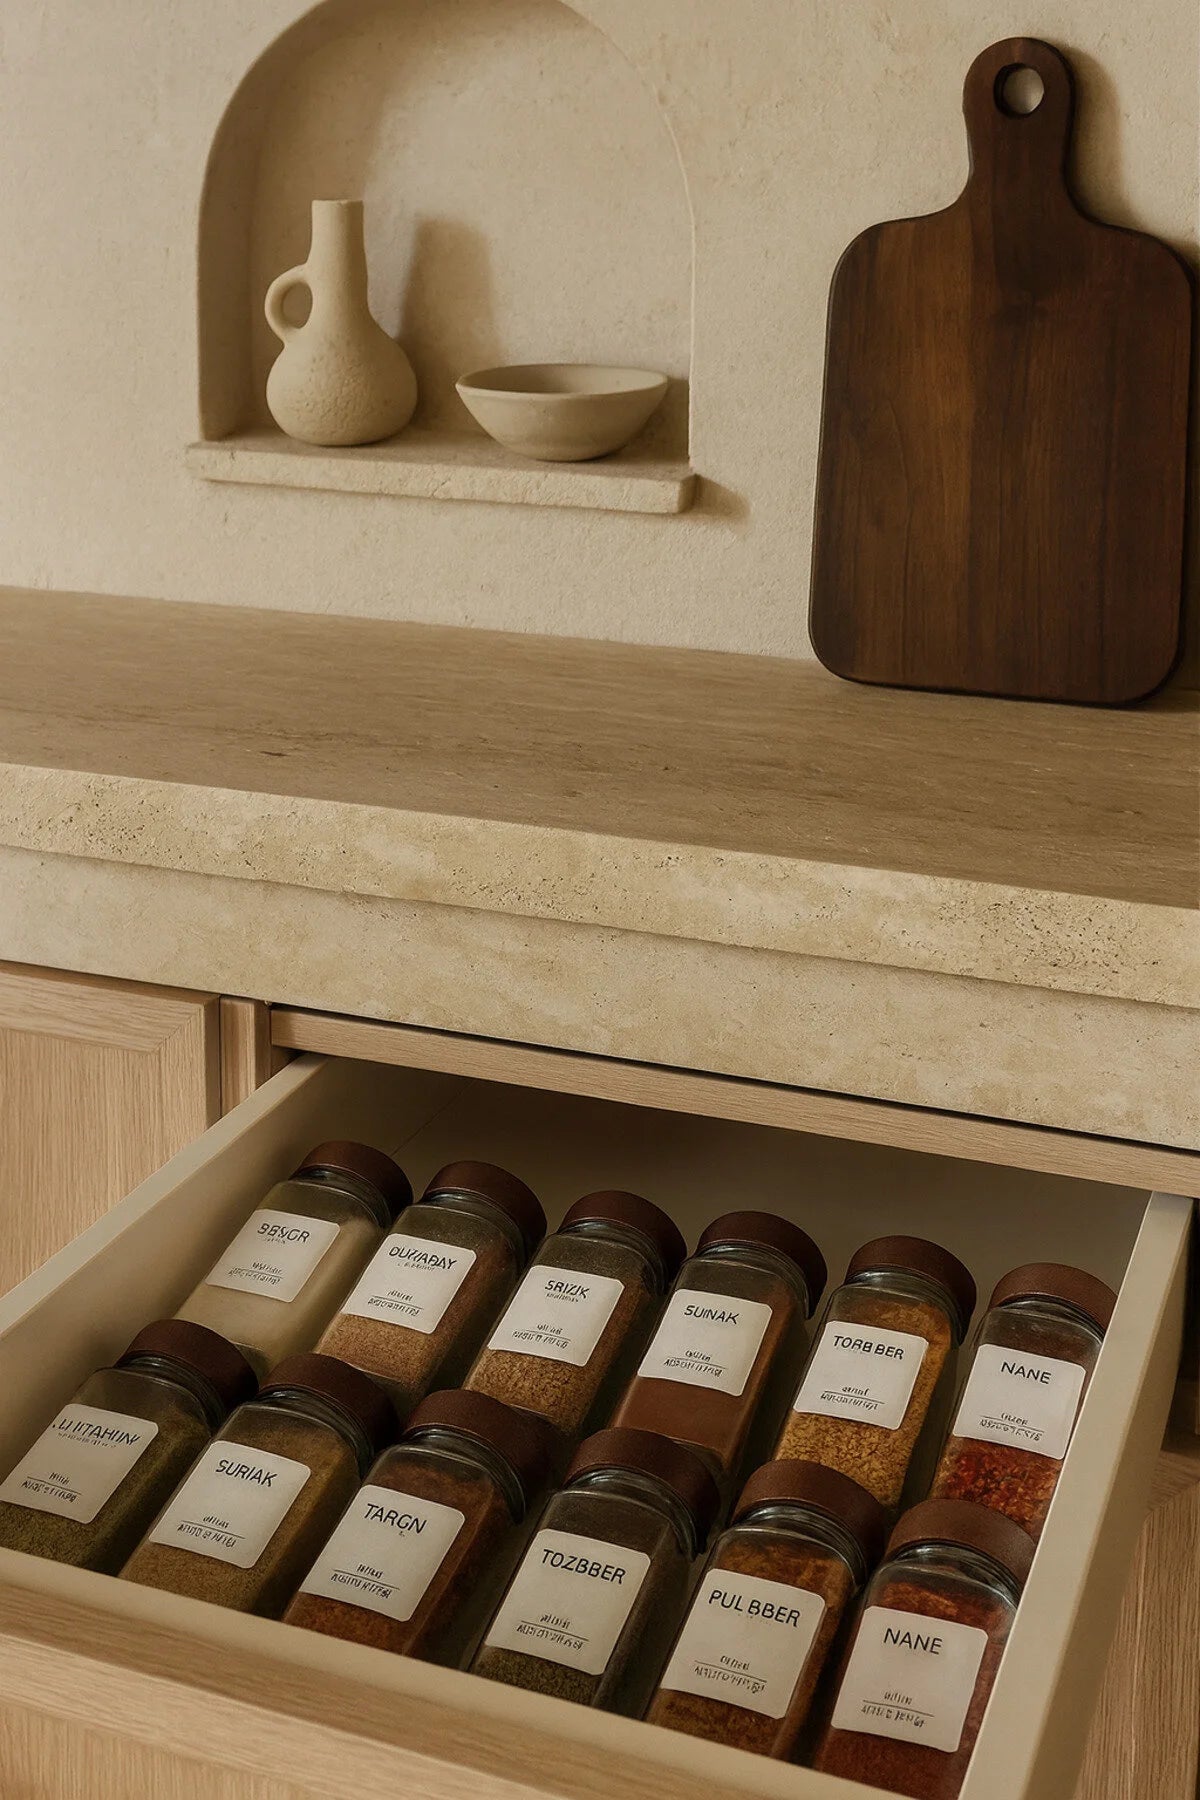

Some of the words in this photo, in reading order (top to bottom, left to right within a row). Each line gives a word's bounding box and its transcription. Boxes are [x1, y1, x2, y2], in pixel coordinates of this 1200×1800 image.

[1000, 1361, 1052, 1384] NANE
[215, 1459, 278, 1488] SURIAK
[541, 1548, 627, 1585] TOZBBER
[883, 1627, 943, 1655] NANE
